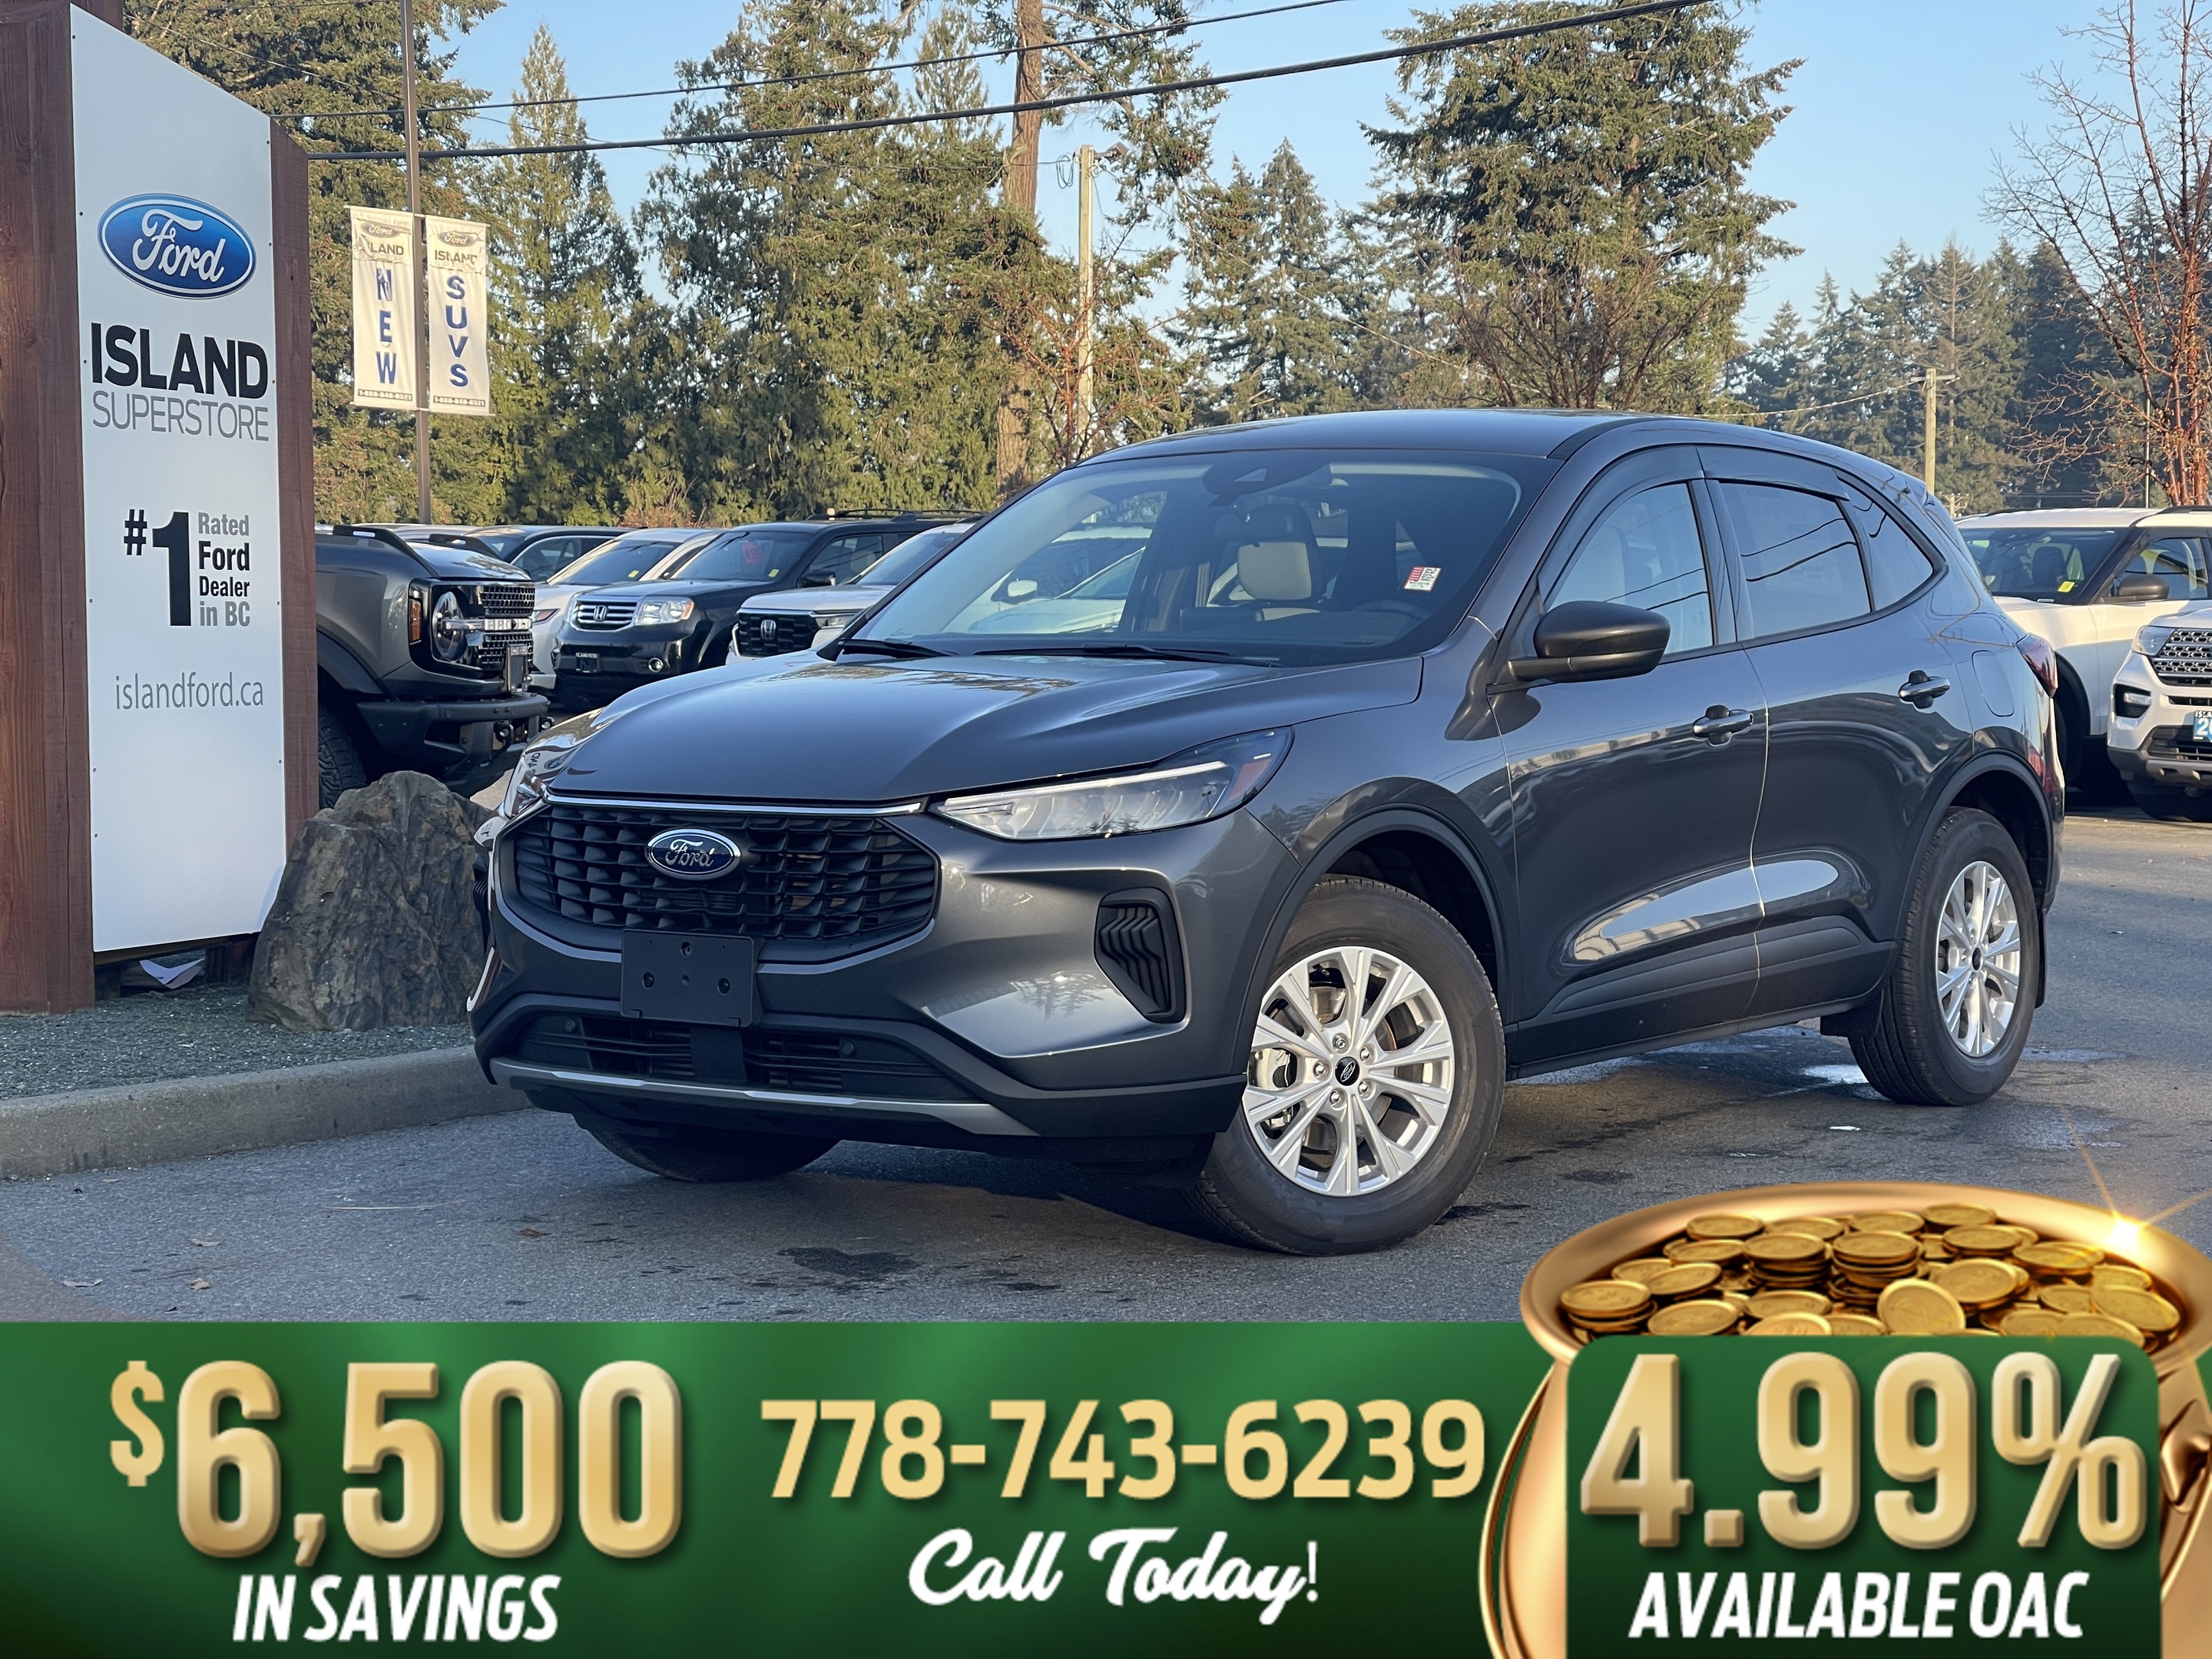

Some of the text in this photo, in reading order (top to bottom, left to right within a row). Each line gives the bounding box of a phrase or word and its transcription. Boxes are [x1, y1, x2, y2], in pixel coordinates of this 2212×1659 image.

[368, 223, 393, 236] Ford
[444, 232, 468, 245] Ford
[132, 209, 227, 282] Ford
[445, 275, 469, 388] SUVS
[91, 322, 269, 399] ISLAND
[92, 389, 269, 442] SUPERSTORE
[198, 512, 250, 536] Rated
[124, 509, 191, 626] #1
[198, 540, 250, 571] Ford
[199, 575, 250, 598] Dealer
[200, 600, 250, 627] in BC
[115, 671, 263, 710] islandford.ca
[664, 839, 715, 867] Ford
